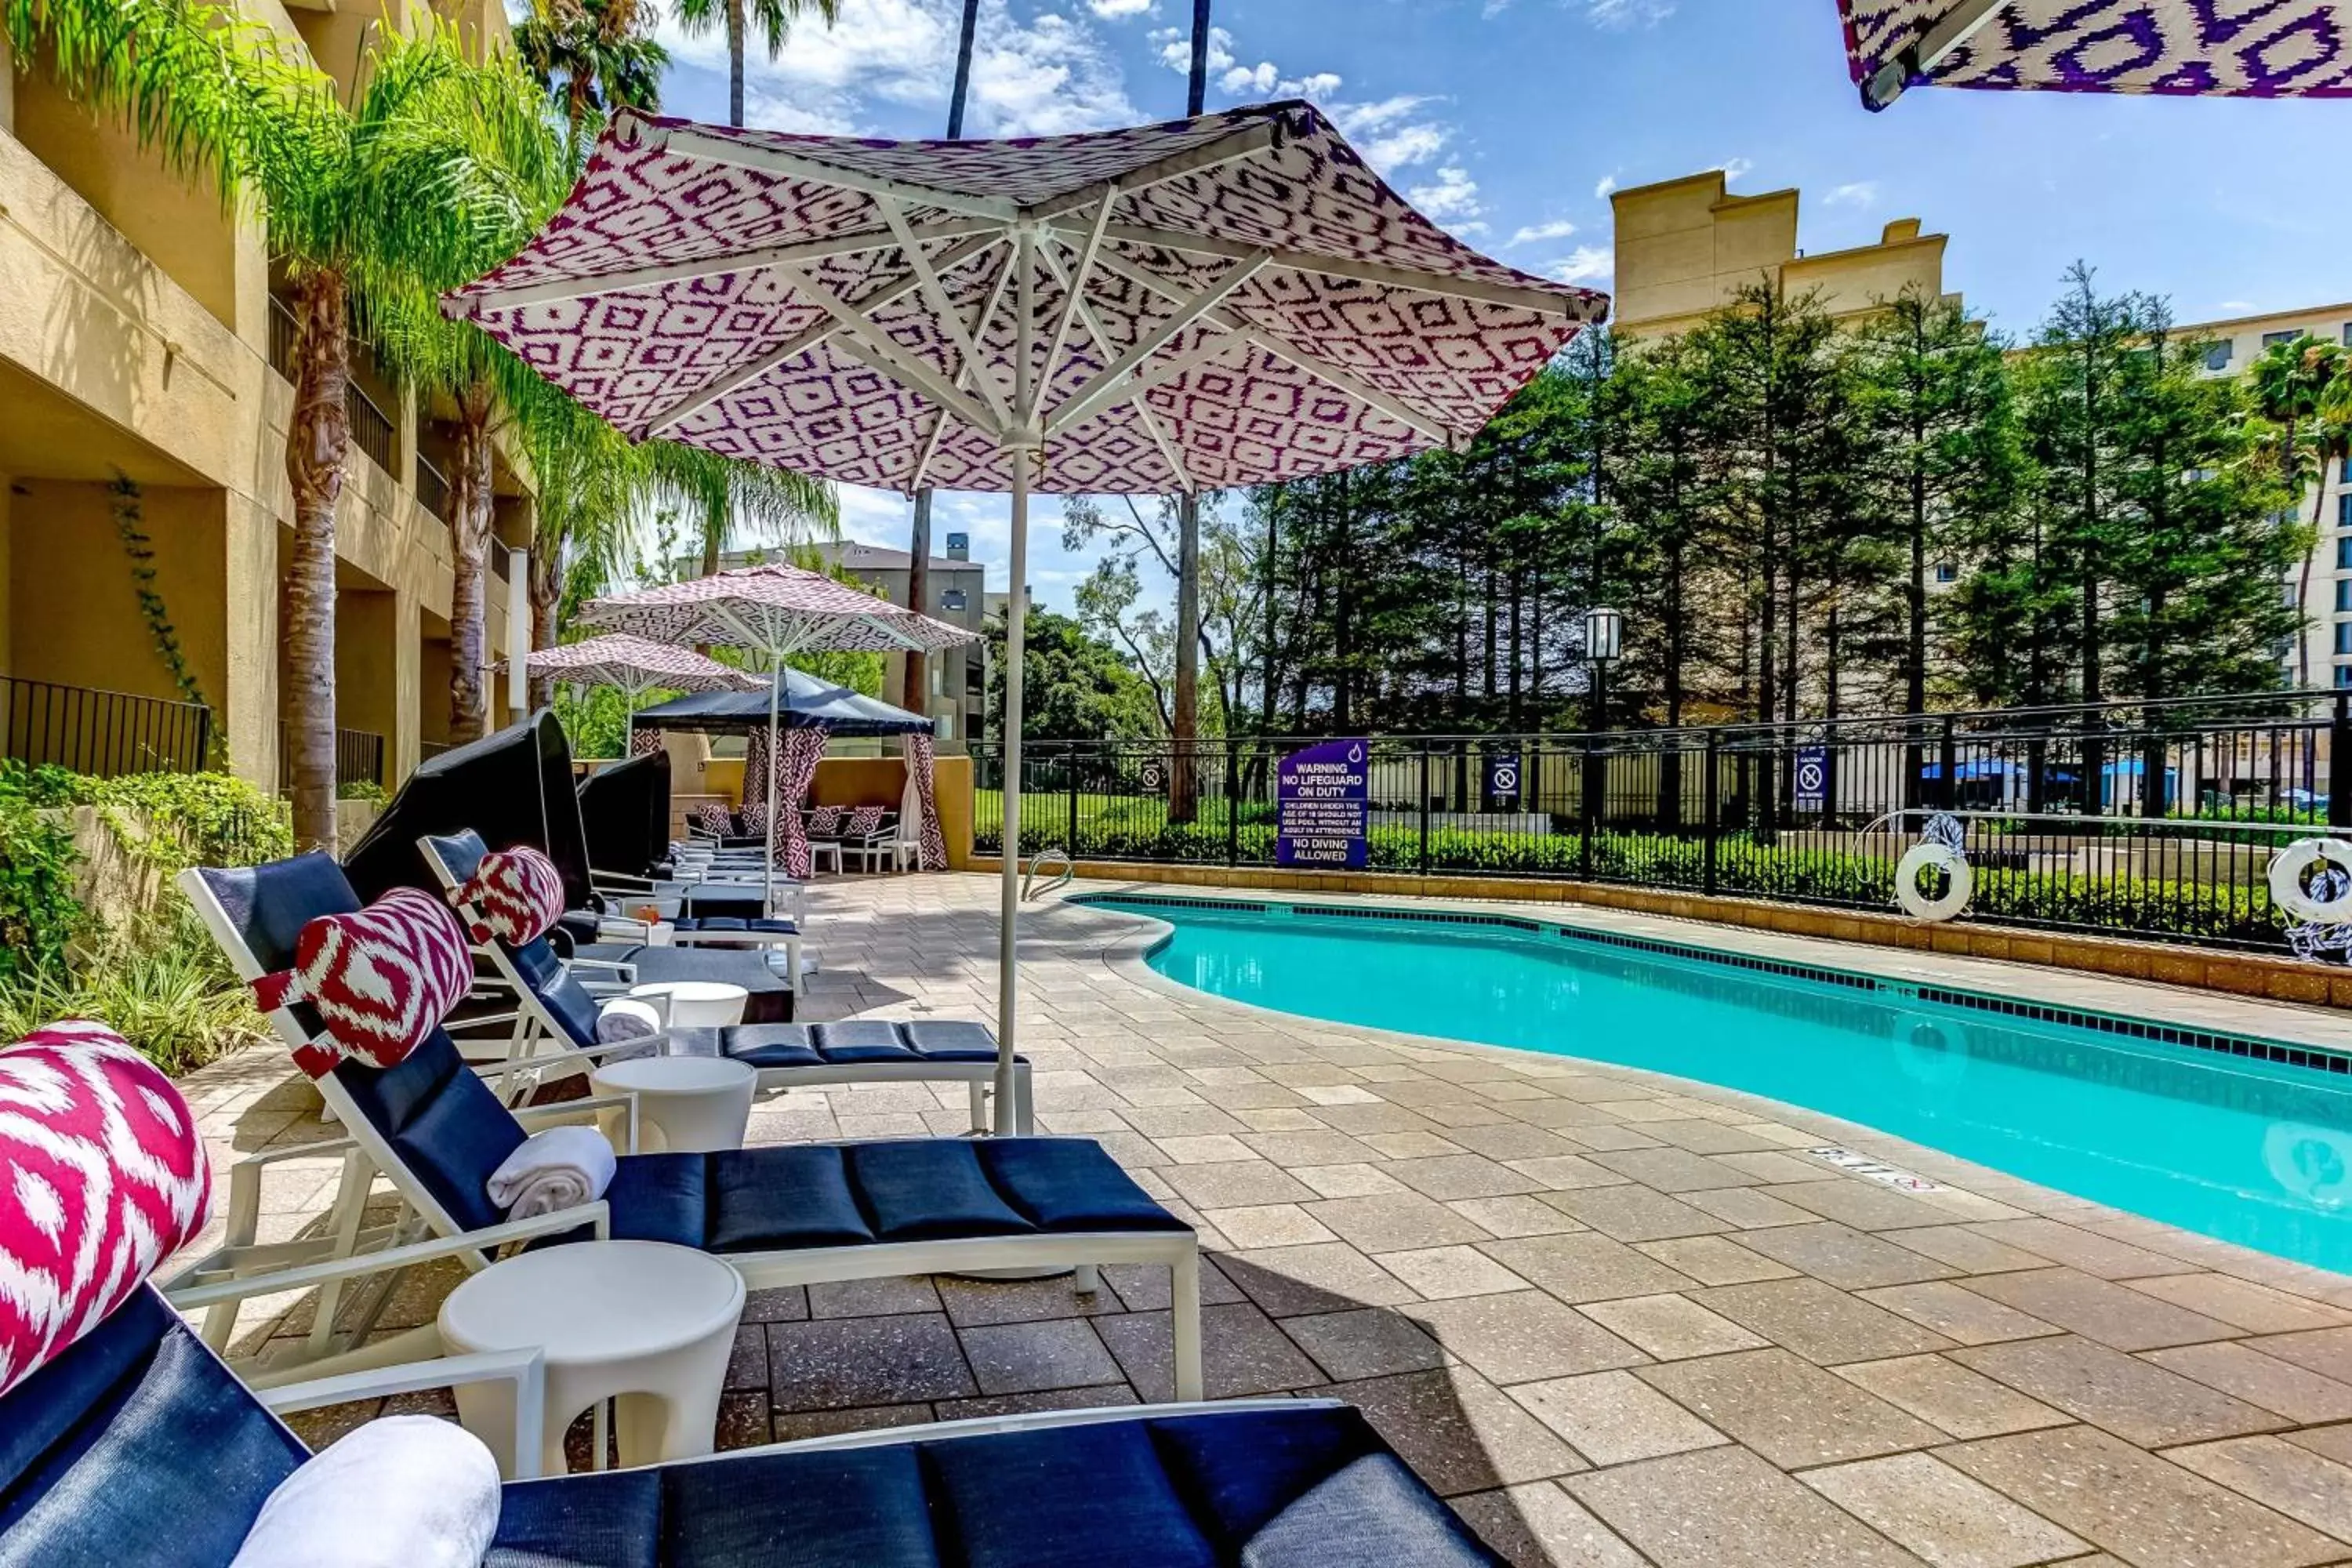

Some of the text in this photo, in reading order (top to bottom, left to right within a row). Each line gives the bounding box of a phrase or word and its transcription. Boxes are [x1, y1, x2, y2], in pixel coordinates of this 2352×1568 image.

[1296, 763, 1348, 774] WARNING
[1282, 775, 1363, 786] NO LIFEGUARD
[1298, 786, 1346, 797] ON DUTY
[1293, 838, 1348, 849] NO DIVING
[1294, 849, 1347, 861] ALLOWED
